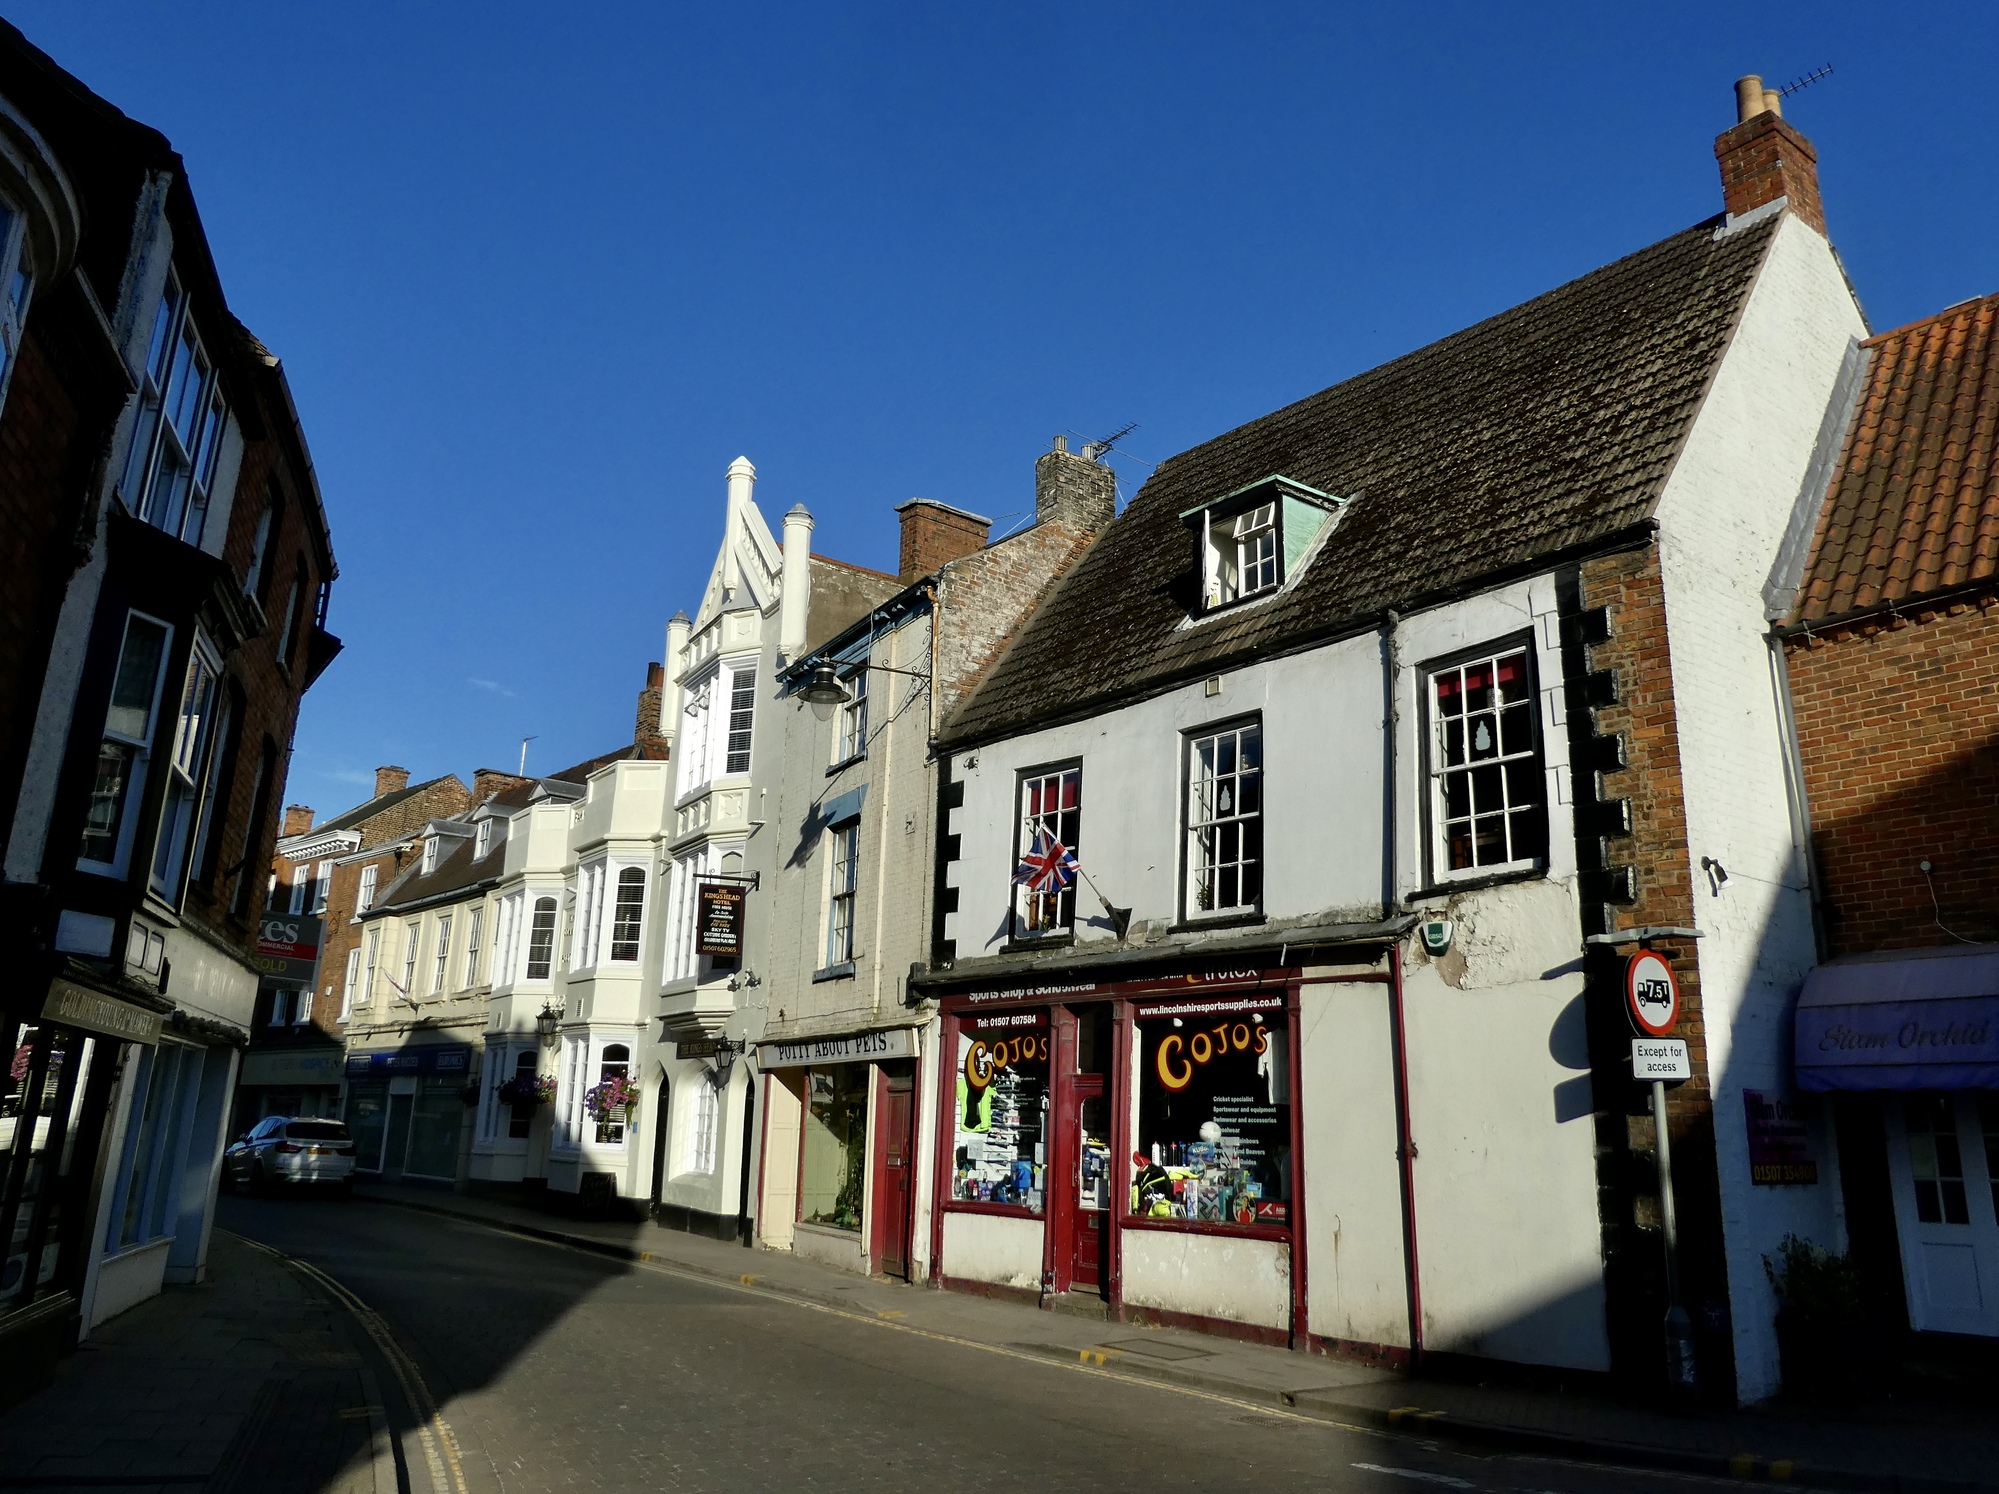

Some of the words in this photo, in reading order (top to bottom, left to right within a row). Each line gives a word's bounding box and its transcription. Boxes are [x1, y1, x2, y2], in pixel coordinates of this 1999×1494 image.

[257, 940, 295, 951] OMMERCIAL
[1139, 997, 1282, 1016] www.lincolnshiresportssupplies.co.uk
[977, 1018, 989, 1028] Tel:
[990, 1017, 1010, 1026] 01507
[1011, 1014, 1037, 1025] 607584
[1819, 1024, 1890, 1051] Siam
[1898, 1020, 1991, 1049] Orchid
[779, 1043, 810, 1060] POTTY
[815, 1037, 850, 1057] ABOUT
[856, 1032, 887, 1053] PETS
[1637, 1045, 1668, 1058] Except
[1670, 1046, 1682, 1057] for
[1647, 1063, 1677, 1072] access
[1754, 1165, 1782, 1181] 01507
